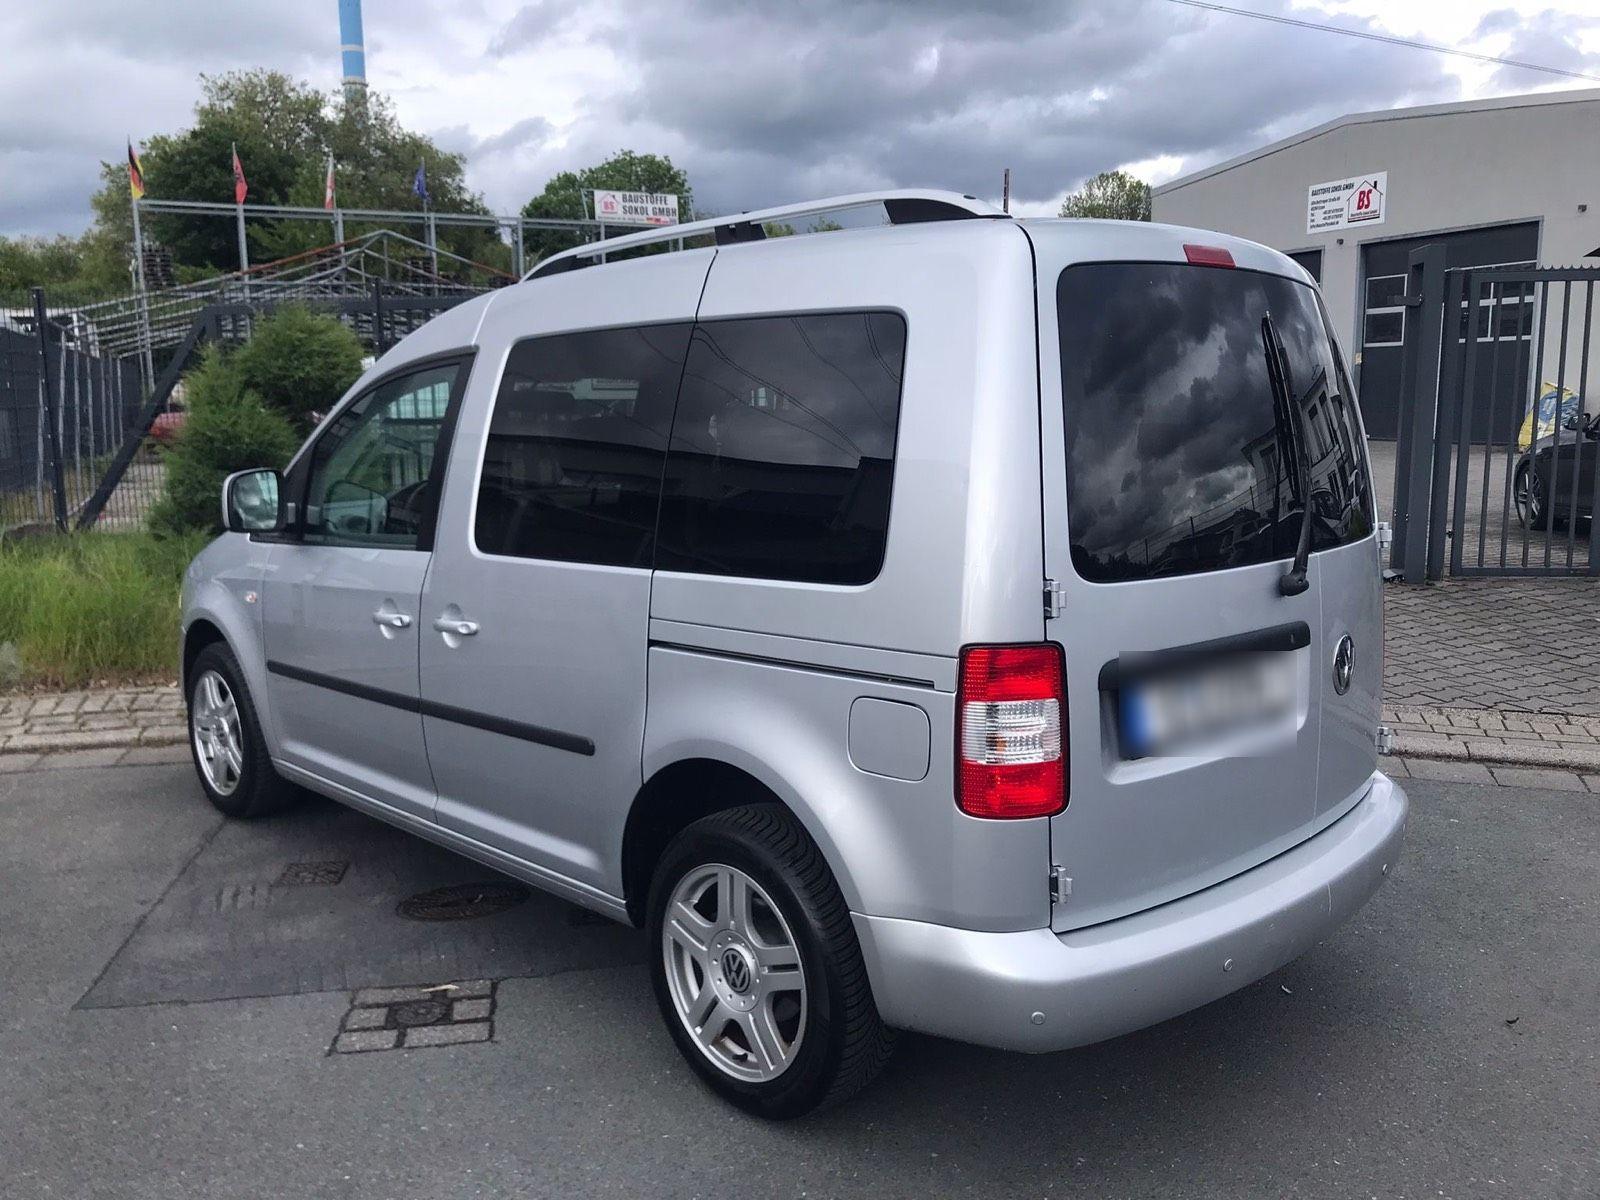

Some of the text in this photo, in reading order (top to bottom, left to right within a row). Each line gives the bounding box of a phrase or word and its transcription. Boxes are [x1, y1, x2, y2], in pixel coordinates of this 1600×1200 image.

[603, 201, 615, 210] BS
[622, 193, 677, 217] BAUSTOFFE SOKOL GMBH
[1357, 189, 1372, 210] BS
[722, 949, 750, 992] VW
